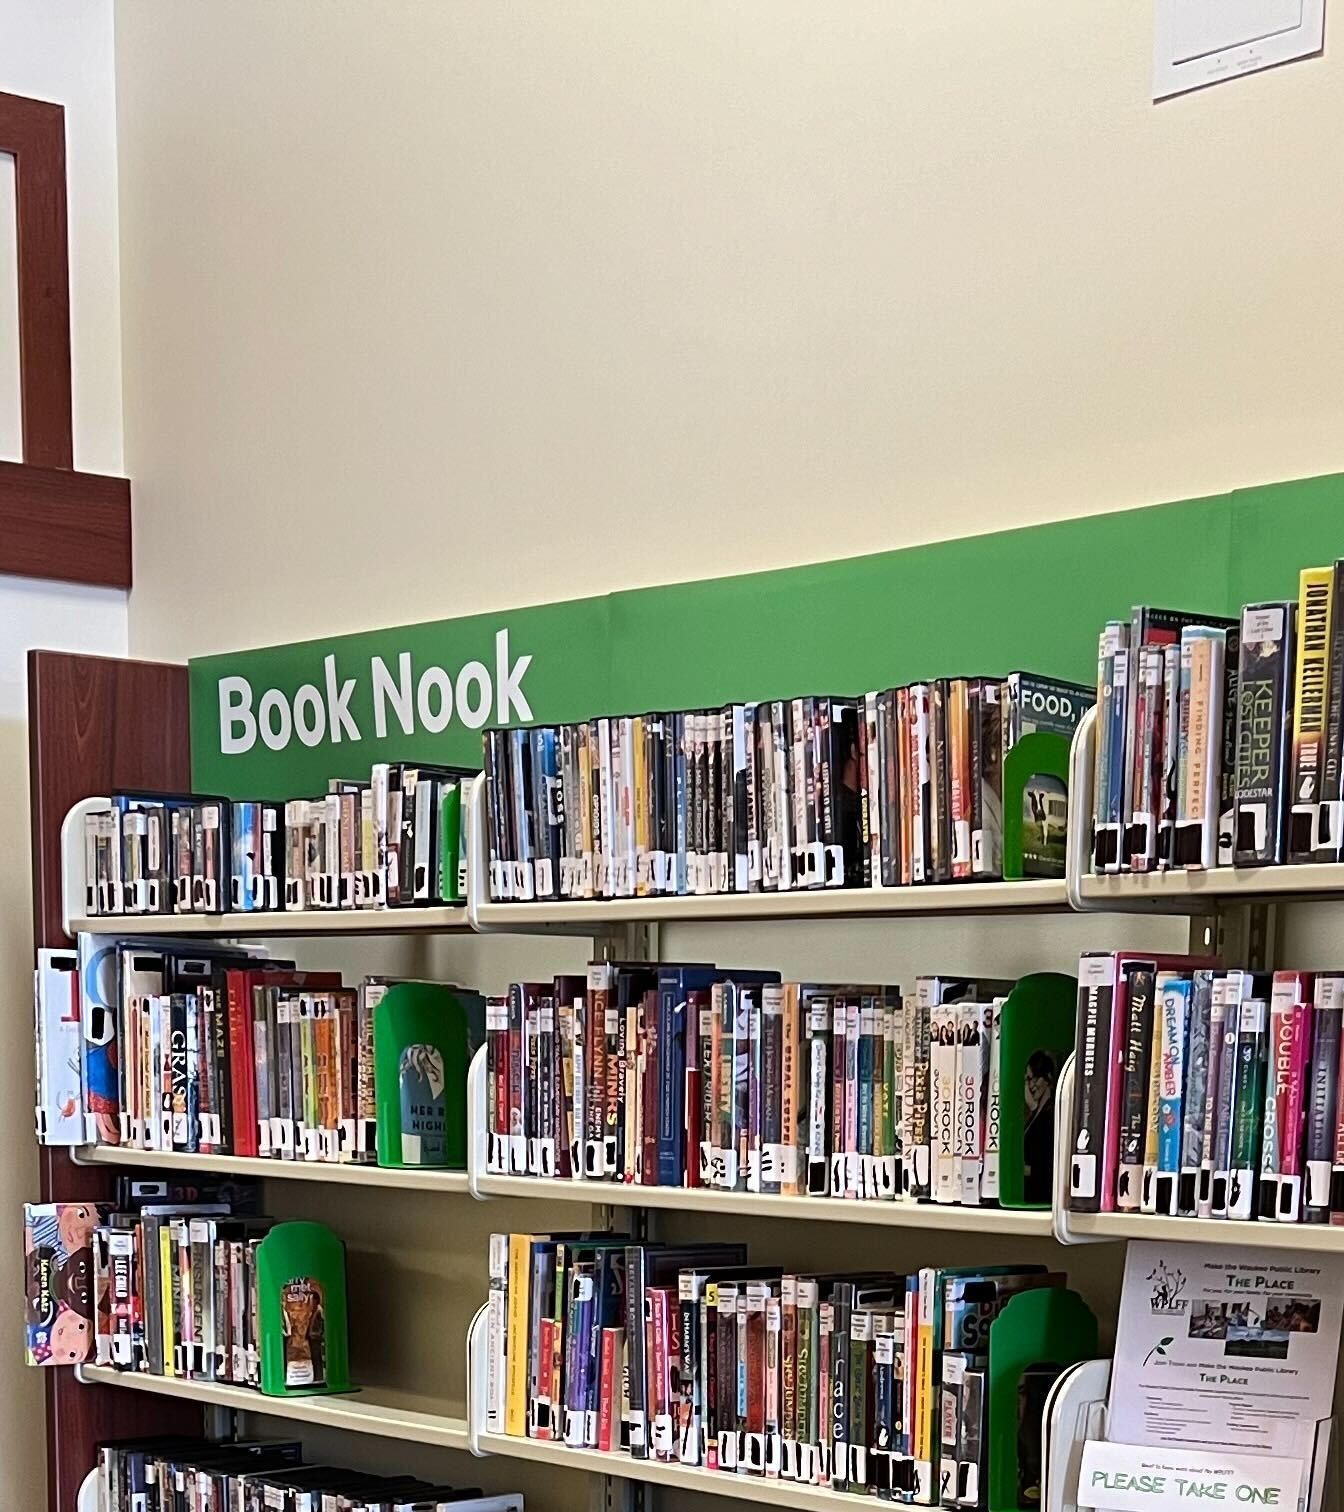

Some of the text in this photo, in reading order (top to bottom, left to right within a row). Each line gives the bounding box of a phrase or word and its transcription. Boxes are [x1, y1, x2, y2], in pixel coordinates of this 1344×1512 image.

[1299, 583, 1328, 733] JONATHAN KELLERMAN
[219, 629, 534, 754] Book Nook
[1021, 690, 1076, 722] FOOD,
[1251, 679, 1274, 786] KEEPER
[1299, 742, 1320, 769] TRUE
[1325, 699, 1341, 781] THE CITY
[592, 1026, 604, 1078] FLYNN
[1084, 1027, 1096, 1076] MURDERS
[1126, 995, 1146, 1072] Matt Haig
[1165, 999, 1180, 1065] DREAM ON
[1276, 1013, 1296, 1096] DOUBLE
[1163, 1053, 1175, 1096] AMBER
[40, 1259, 49, 1312] Karen Katz
[1092, 1471, 1280, 1504] PLEASE TAKE ONE
